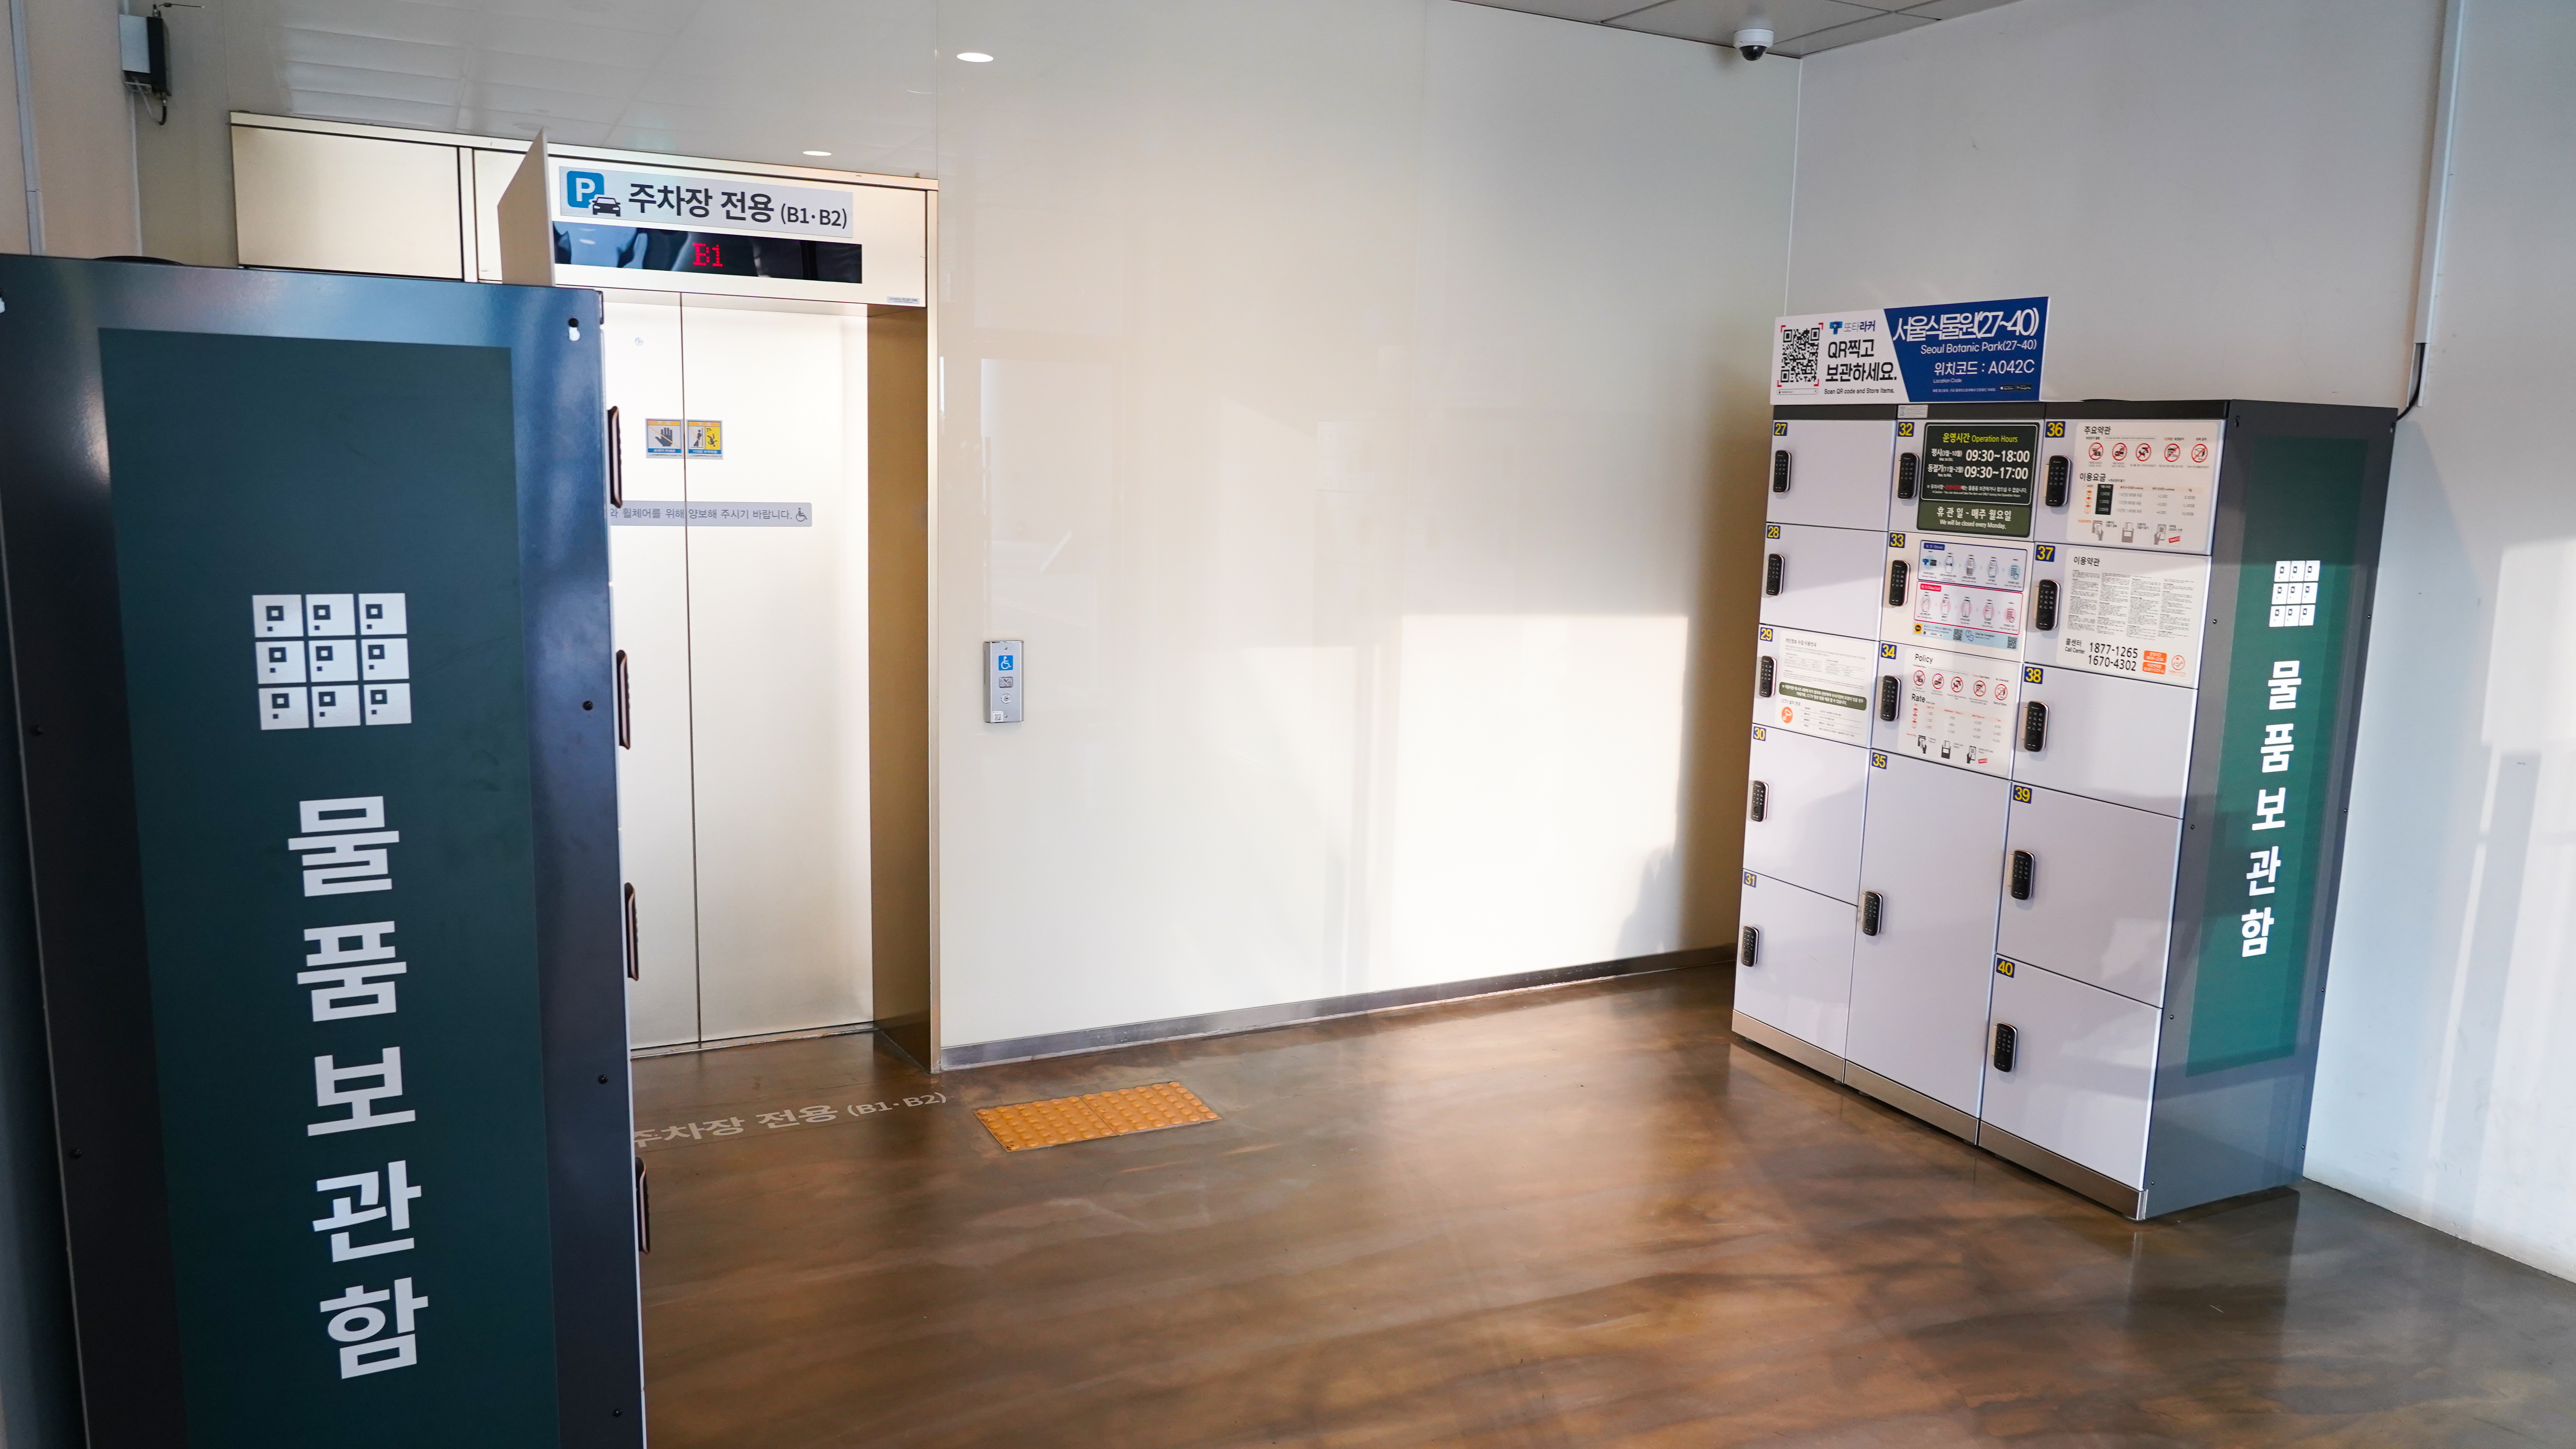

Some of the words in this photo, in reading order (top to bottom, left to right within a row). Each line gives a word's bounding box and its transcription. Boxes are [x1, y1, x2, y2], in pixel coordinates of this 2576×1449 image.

[629, 183, 713, 218] 주차장
[720, 191, 774, 223] 전용
[693, 243, 723, 267] B1
[1844, 320, 1876, 332] 또타라커
[1893, 307, 2039, 342] 서울식물원(27~40)
[1828, 339, 1874, 359] QR찍고
[1920, 344, 1944, 355] Seoul
[1946, 343, 1980, 353] Botanic
[1981, 339, 2037, 352] Park(27~40)
[1826, 362, 1897, 382] 보관하세요.
[1934, 361, 1978, 376] 위치코드
[1988, 359, 2035, 374] A042C
[1775, 423, 1787, 435] 27
[1899, 423, 1913, 437] 32
[2047, 423, 2063, 437] 36
[2084, 426, 2111, 435] 주요약관
[1943, 433, 1970, 443] 운영시간
[1966, 449, 2030, 463] 09:30~18:00
[1964, 466, 2028, 479] 09:30~17:00
[2080, 473, 2106, 482] 이용요금
[622, 508, 662, 519] 휠체어를
[665, 509, 685, 519] 위해
[689, 509, 717, 519] 양보해
[720, 509, 749, 520] 주시기
[753, 509, 793, 520] 바랍니다.
[1937, 506, 1944, 517] 휴
[1946, 507, 1954, 518] 관
[1956, 508, 1963, 518] 일
[1971, 509, 1986, 519] 매주
[1989, 509, 2011, 521] 월요일
[1768, 526, 1780, 539] 28
[1890, 534, 1905, 547] 33
[2038, 546, 2054, 561] 37
[2074, 556, 2100, 567] 이용약관
[1761, 629, 1772, 641] 29
[1882, 645, 1896, 658] 34
[2066, 638, 2082, 647] 콜센터
[2090, 642, 2138, 658] 1877-1265
[1915, 654, 1933, 664] Policy
[2088, 655, 2136, 671] 1670-4302
[2026, 668, 2042, 684] 38
[1911, 694, 1926, 703] Rate
[1754, 727, 1766, 740] 30
[1873, 754, 1886, 769] 35
[2015, 786, 2031, 802] 39
[2242, 661, 2302, 957] 물품보관함
[1745, 873, 1756, 885] 31
[1998, 961, 2014, 976] 40
[288, 796, 429, 1380] 물품보관함
[633, 1116, 745, 1148] 주차장
[756, 1105, 838, 1129] 전용
